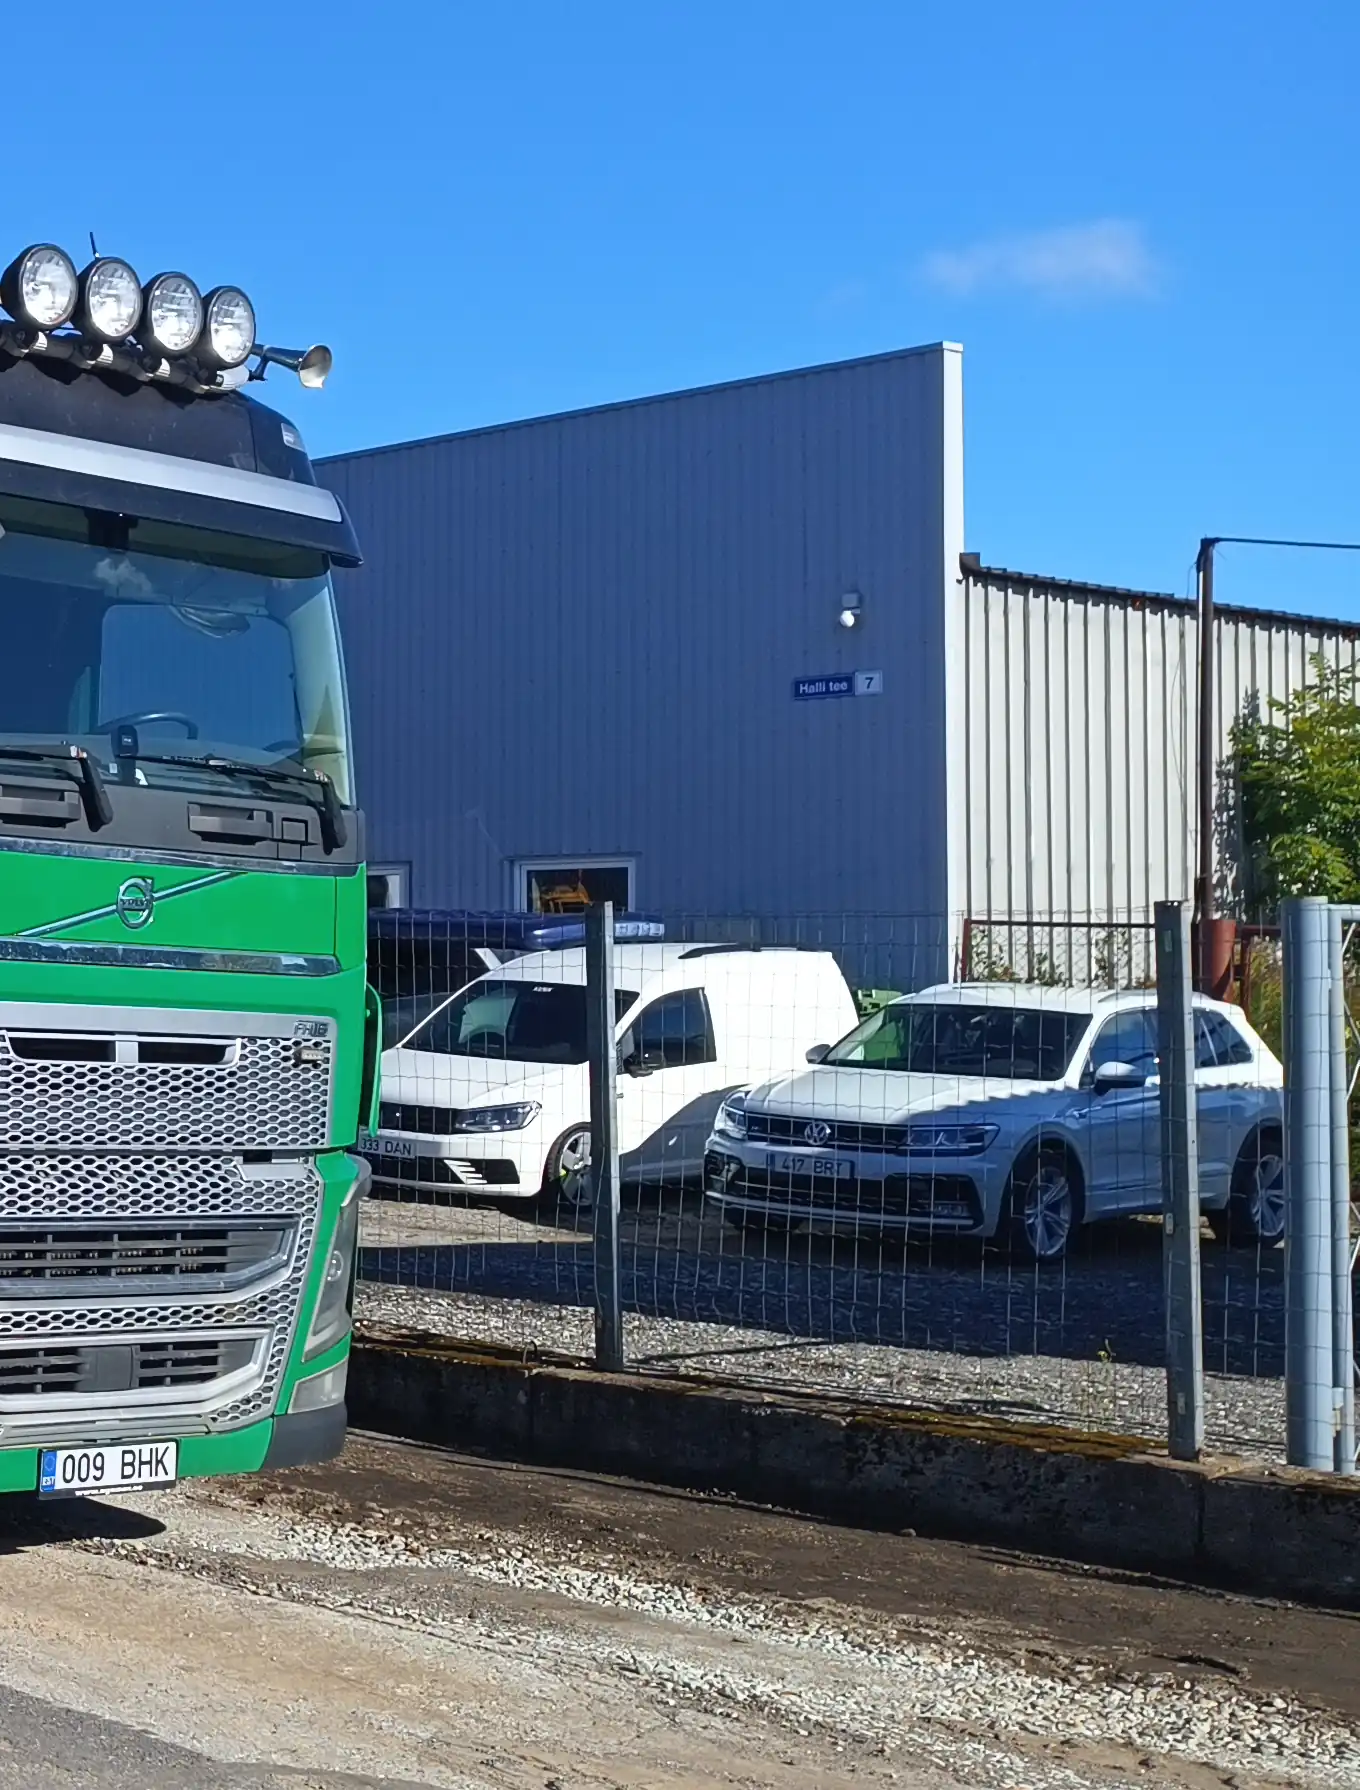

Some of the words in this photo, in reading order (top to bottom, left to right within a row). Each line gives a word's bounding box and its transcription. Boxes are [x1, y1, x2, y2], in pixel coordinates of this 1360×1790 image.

[864, 676, 875, 690] 7
[384, 1140, 412, 1156] DAN
[781, 1157, 805, 1173] 417
[813, 1160, 842, 1177] BRT
[62, 1453, 105, 1484] 009
[120, 1445, 170, 1480] BHK
